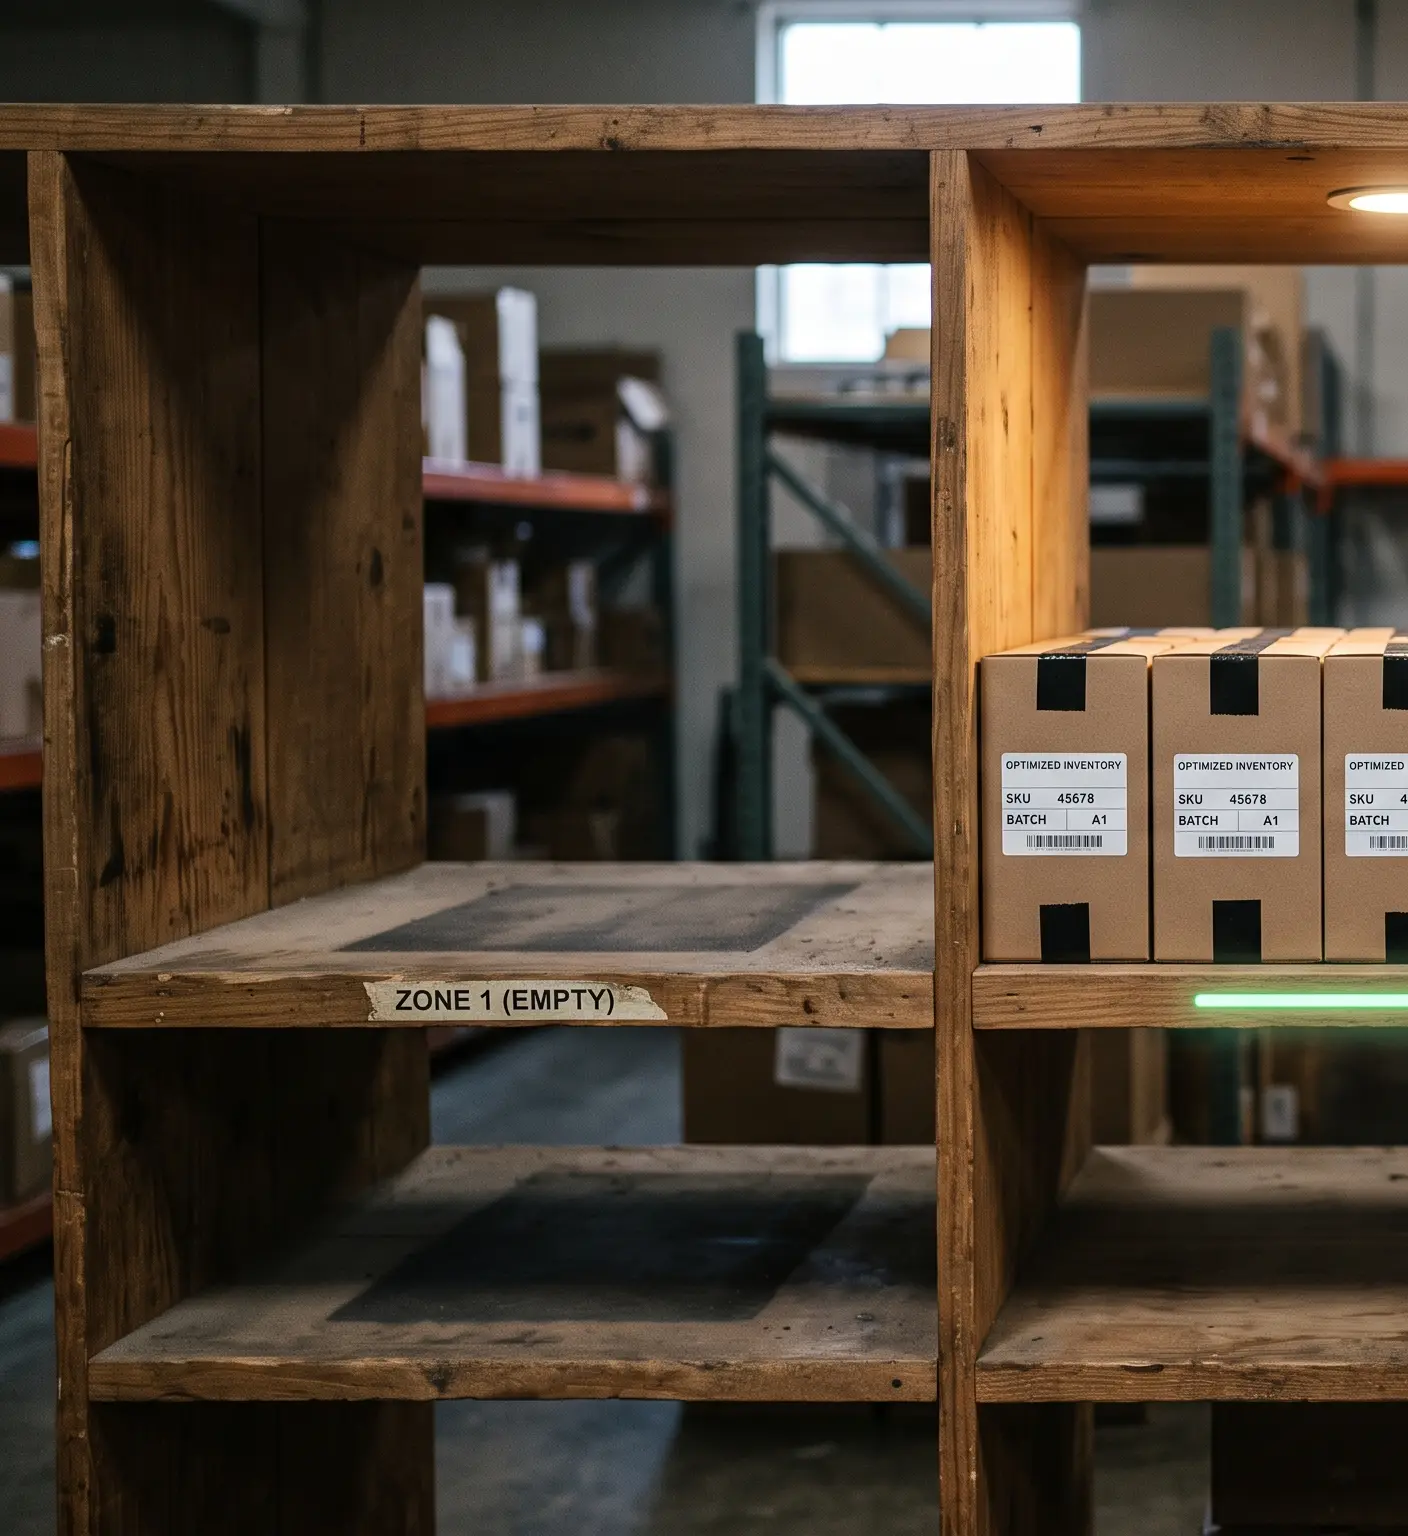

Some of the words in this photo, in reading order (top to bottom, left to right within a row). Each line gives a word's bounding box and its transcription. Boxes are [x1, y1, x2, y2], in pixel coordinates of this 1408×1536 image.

[1005, 760, 1061, 770] OPTIMIZED
[1063, 760, 1122, 770] INVENTORY
[1177, 761, 1233, 771] OPTIMIZED
[1235, 761, 1294, 771] INVENTORY
[1348, 761, 1404, 771] OPTIMIZED
[1006, 793, 1031, 804] SKU
[1057, 793, 1095, 804] 45678
[1178, 794, 1203, 805] SKU
[1229, 794, 1267, 805] 45678
[1349, 794, 1374, 805] SKU
[1006, 814, 1047, 825] BATCH
[1091, 814, 1107, 825] A1
[1178, 815, 1219, 826] BATCH
[1263, 815, 1279, 826] A1
[1349, 815, 1390, 826] BATCH
[395, 989, 471, 1011] ZONE
[480, 989, 492, 1011] 1
[502, 988, 615, 1016] (EMPTY)
